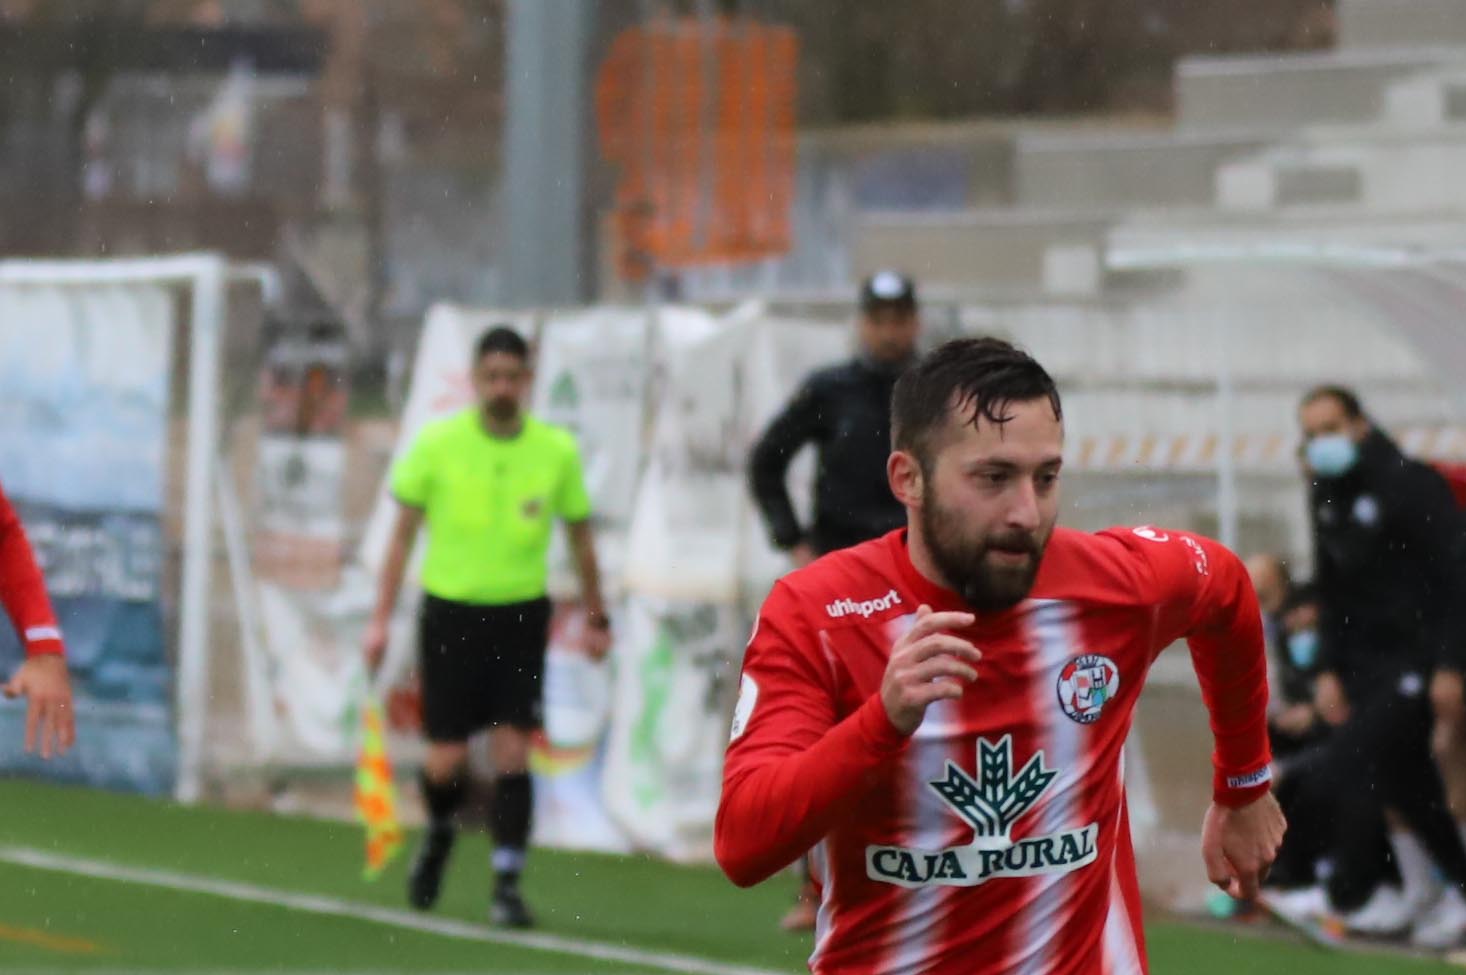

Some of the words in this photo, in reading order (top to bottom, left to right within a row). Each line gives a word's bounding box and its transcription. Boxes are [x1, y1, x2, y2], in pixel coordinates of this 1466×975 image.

[825, 589, 902, 618] uhlsport
[872, 850, 967, 882] CAJA
[978, 829, 1094, 879] RURAL
